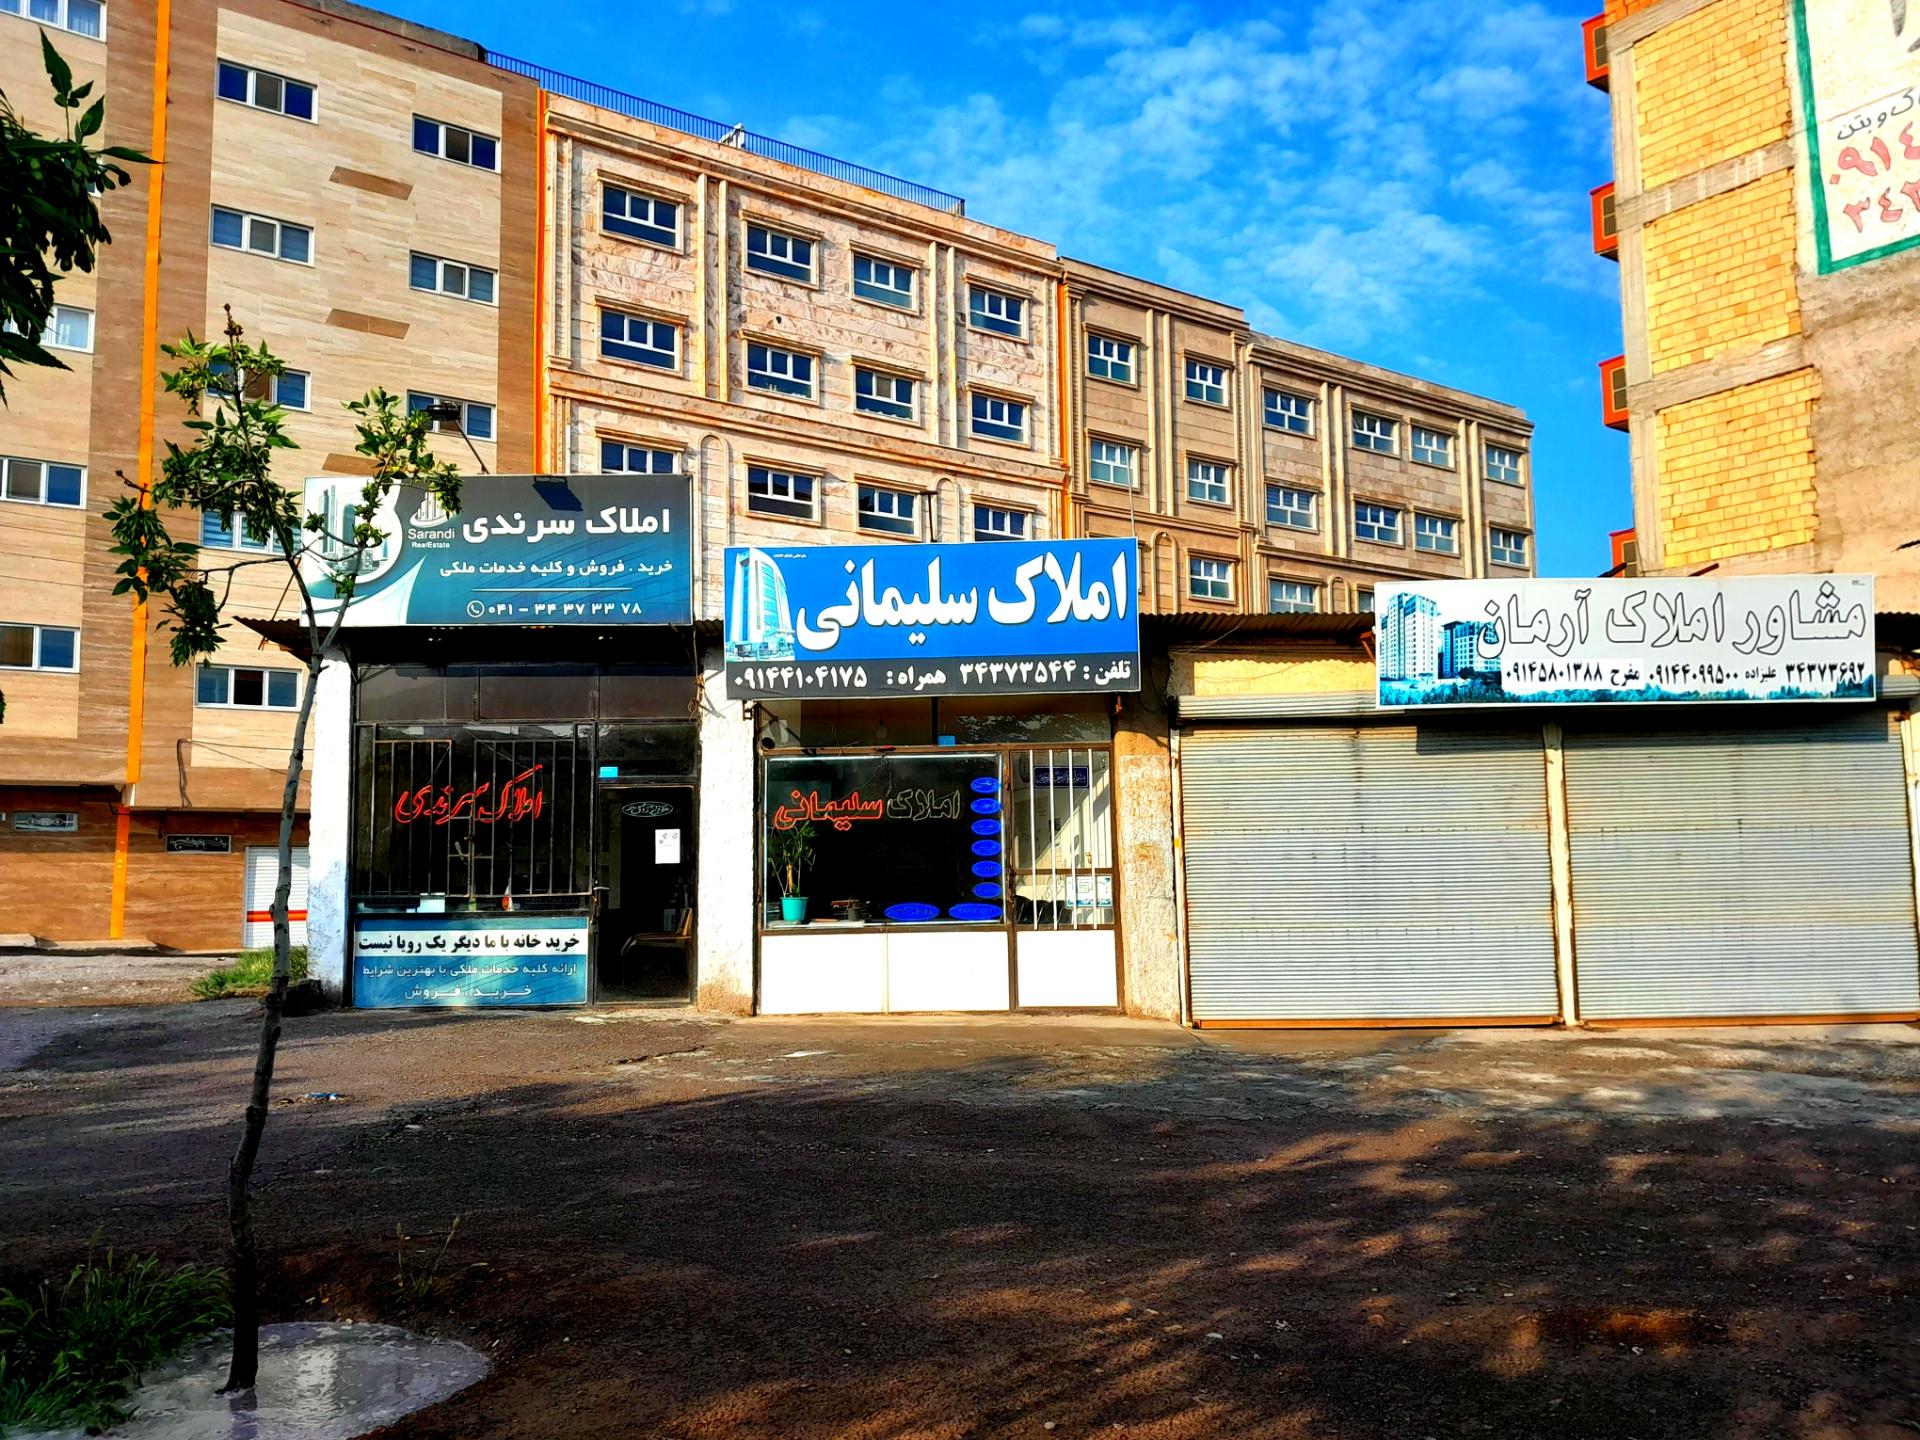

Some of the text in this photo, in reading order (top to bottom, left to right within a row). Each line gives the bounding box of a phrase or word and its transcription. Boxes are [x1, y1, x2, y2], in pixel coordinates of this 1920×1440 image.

[1837, 87, 1920, 140] ک و بتن
[462, 506, 671, 544] املاک سرندی
[408, 527, 455, 540] Sarandi
[439, 561, 475, 577] ملکی
[479, 561, 526, 574] خدمات
[531, 560, 563, 575] کلیه
[566, 565, 575, 576] و
[578, 560, 625, 577] فروش
[637, 560, 673, 575] خرید
[795, 551, 1127, 651] املاک سلیمانی
[1476, 581, 1867, 659] مشاور املاک آرمان
[734, 665, 868, 690] ۰۹۱۴۴۱۰۴۱۷۵
[959, 659, 1077, 685] ۳۴۳۷۳۵۴۴
[395, 764, 543, 825] املاک سرندی
[774, 789, 884, 831] سلیمانی
[887, 789, 960, 821] املاک
[358, 933, 580, 953] خرید خانه با ما دیگر یک رویا نیست
[362, 964, 394, 977] شرایط
[396, 964, 436, 977] بهترین
[438, 965, 447, 976] با
[450, 962, 478, 977] ملکی
[481, 962, 519, 974] خدمات
[522, 962, 548, 975] کلیه
